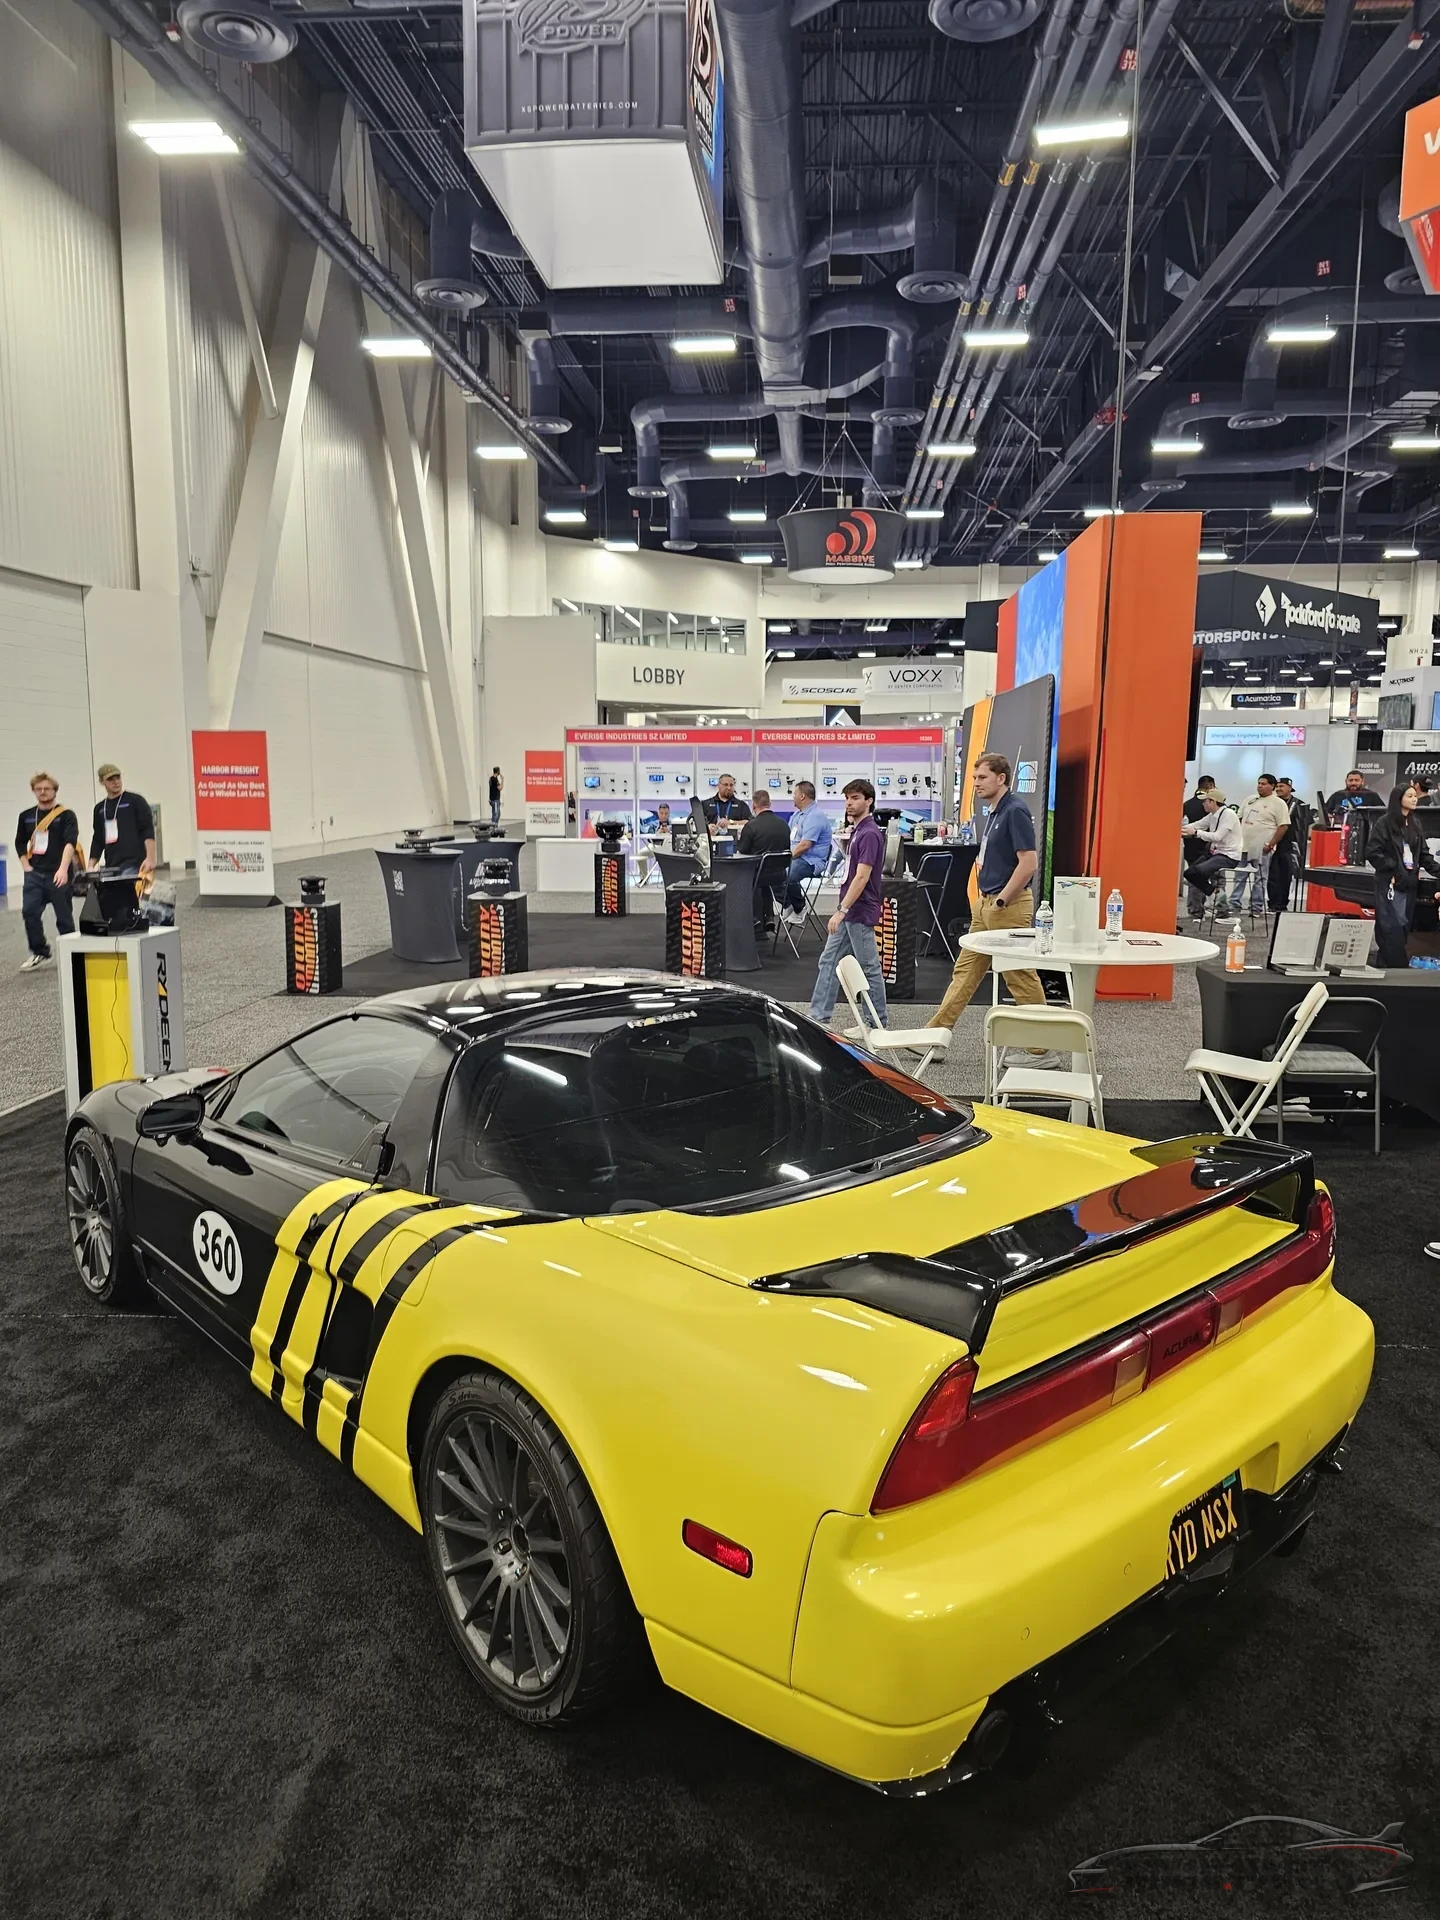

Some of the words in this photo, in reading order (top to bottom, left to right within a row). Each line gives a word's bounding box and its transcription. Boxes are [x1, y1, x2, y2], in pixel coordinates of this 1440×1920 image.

[543, 23, 616, 39] POWER
[521, 101, 638, 113] XSPOWERBATTERIES.COM
[825, 554, 875, 564] MASSIVE
[633, 666, 685, 685] LOBBY
[889, 669, 943, 682] VOXX
[574, 732, 604, 741] EVERISE
[606, 732, 647, 741] INDUSTRIES
[648, 732, 659, 741] SZ
[659, 732, 688, 741] LIMITED
[762, 732, 792, 741] EVERISE
[793, 732, 836, 741] INDUSTRIES
[837, 732, 847, 741] SZ
[847, 732, 876, 741] LIMITED
[201, 765, 230, 775] HARBOR
[230, 765, 260, 775] FREIGHT
[1405, 761, 1440, 771] Auto
[208, 781, 226, 790] Good
[237, 781, 248, 790] the
[249, 781, 265, 790] Best
[215, 789, 236, 798] Whole
[237, 789, 248, 798] Lot
[249, 789, 265, 798] Less
[199, 1218, 236, 1281] 360
[1162, 1331, 1200, 1360] ACURA
[1201, 1488, 1238, 1549] NSX
